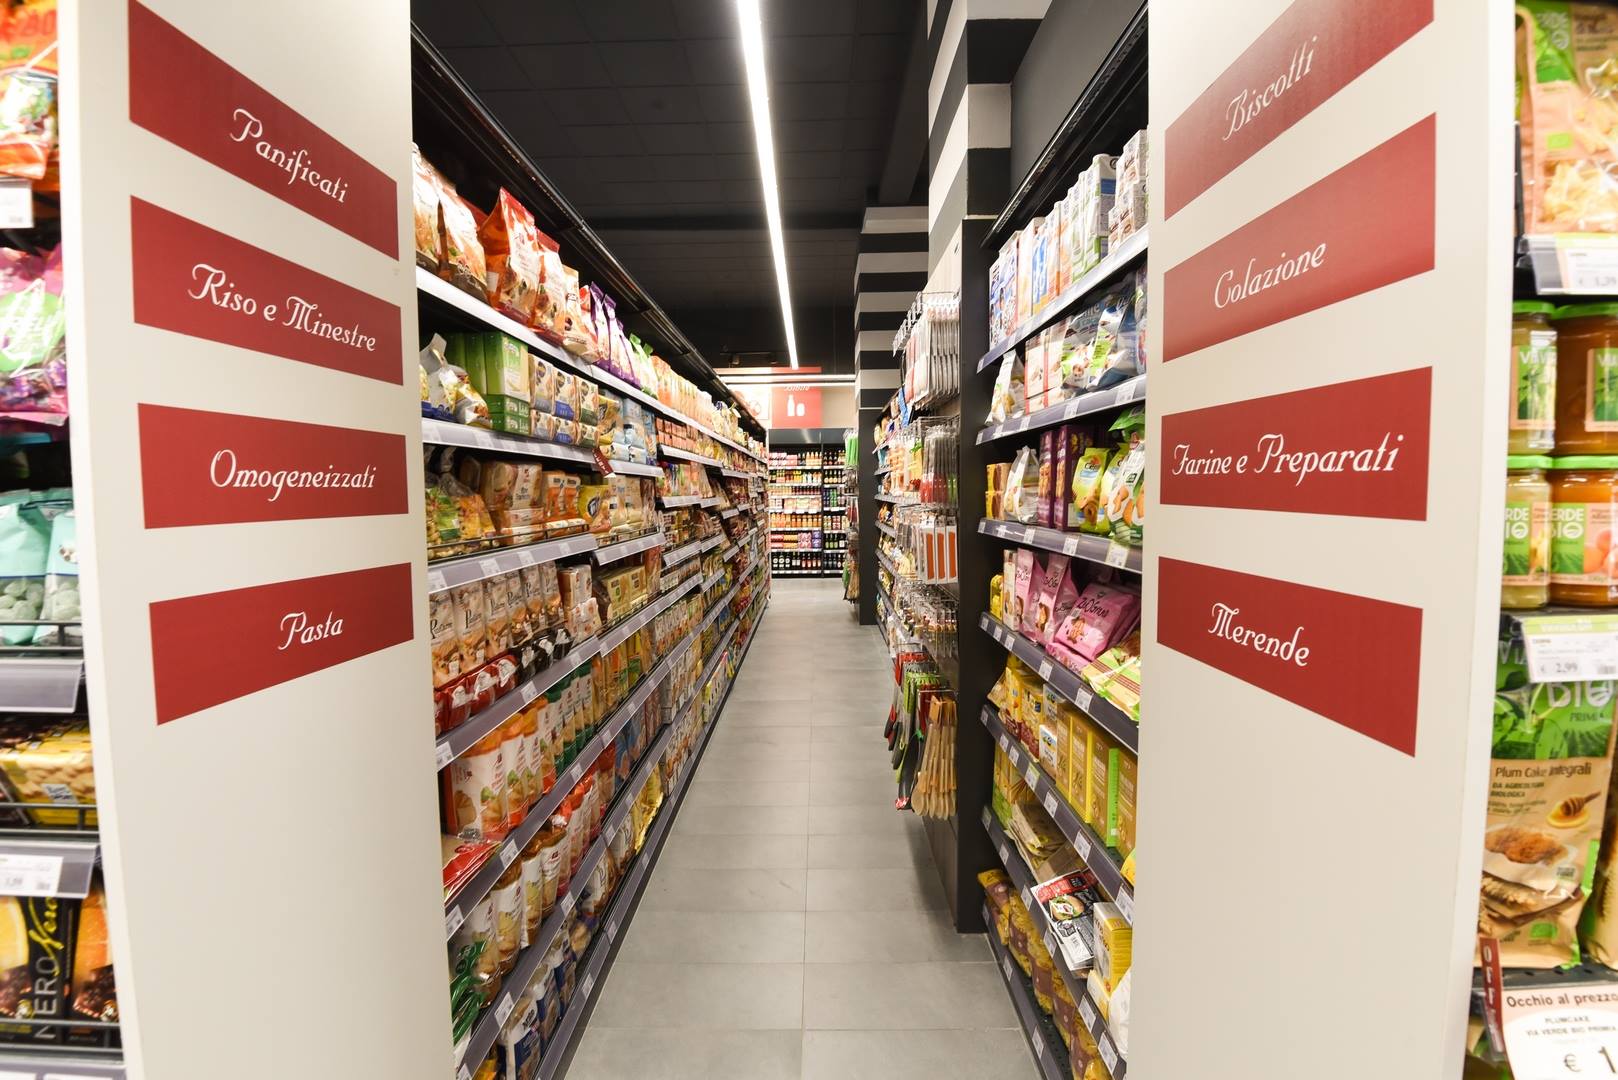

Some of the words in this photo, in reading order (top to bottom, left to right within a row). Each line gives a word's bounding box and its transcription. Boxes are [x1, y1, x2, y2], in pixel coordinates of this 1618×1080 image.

[1222, 36, 1318, 141] Biscotti
[229, 108, 348, 203] Panificati
[1214, 243, 1327, 309] Colazione
[187, 263, 257, 316] Riso
[263, 303, 277, 321] e
[282, 296, 376, 352] Minestre
[210, 449, 376, 502] Omogeneizzati
[1172, 444, 1232, 475] Farine
[1236, 455, 1248, 474] e
[1254, 431, 1404, 486] Preparati
[1505, 508, 1529, 520] RDE
[1505, 522, 1528, 539] IO
[1551, 508, 1585, 521] ERDE
[277, 610, 344, 650] Pasta
[1208, 602, 1310, 666] Merende
[1495, 766, 1522, 778] Plum
[35, 957, 57, 1039] NERO
[1506, 994, 1553, 1008] Occhio
[1558, 993, 1570, 1005] al
[1564, 1053, 1583, 1073] €
